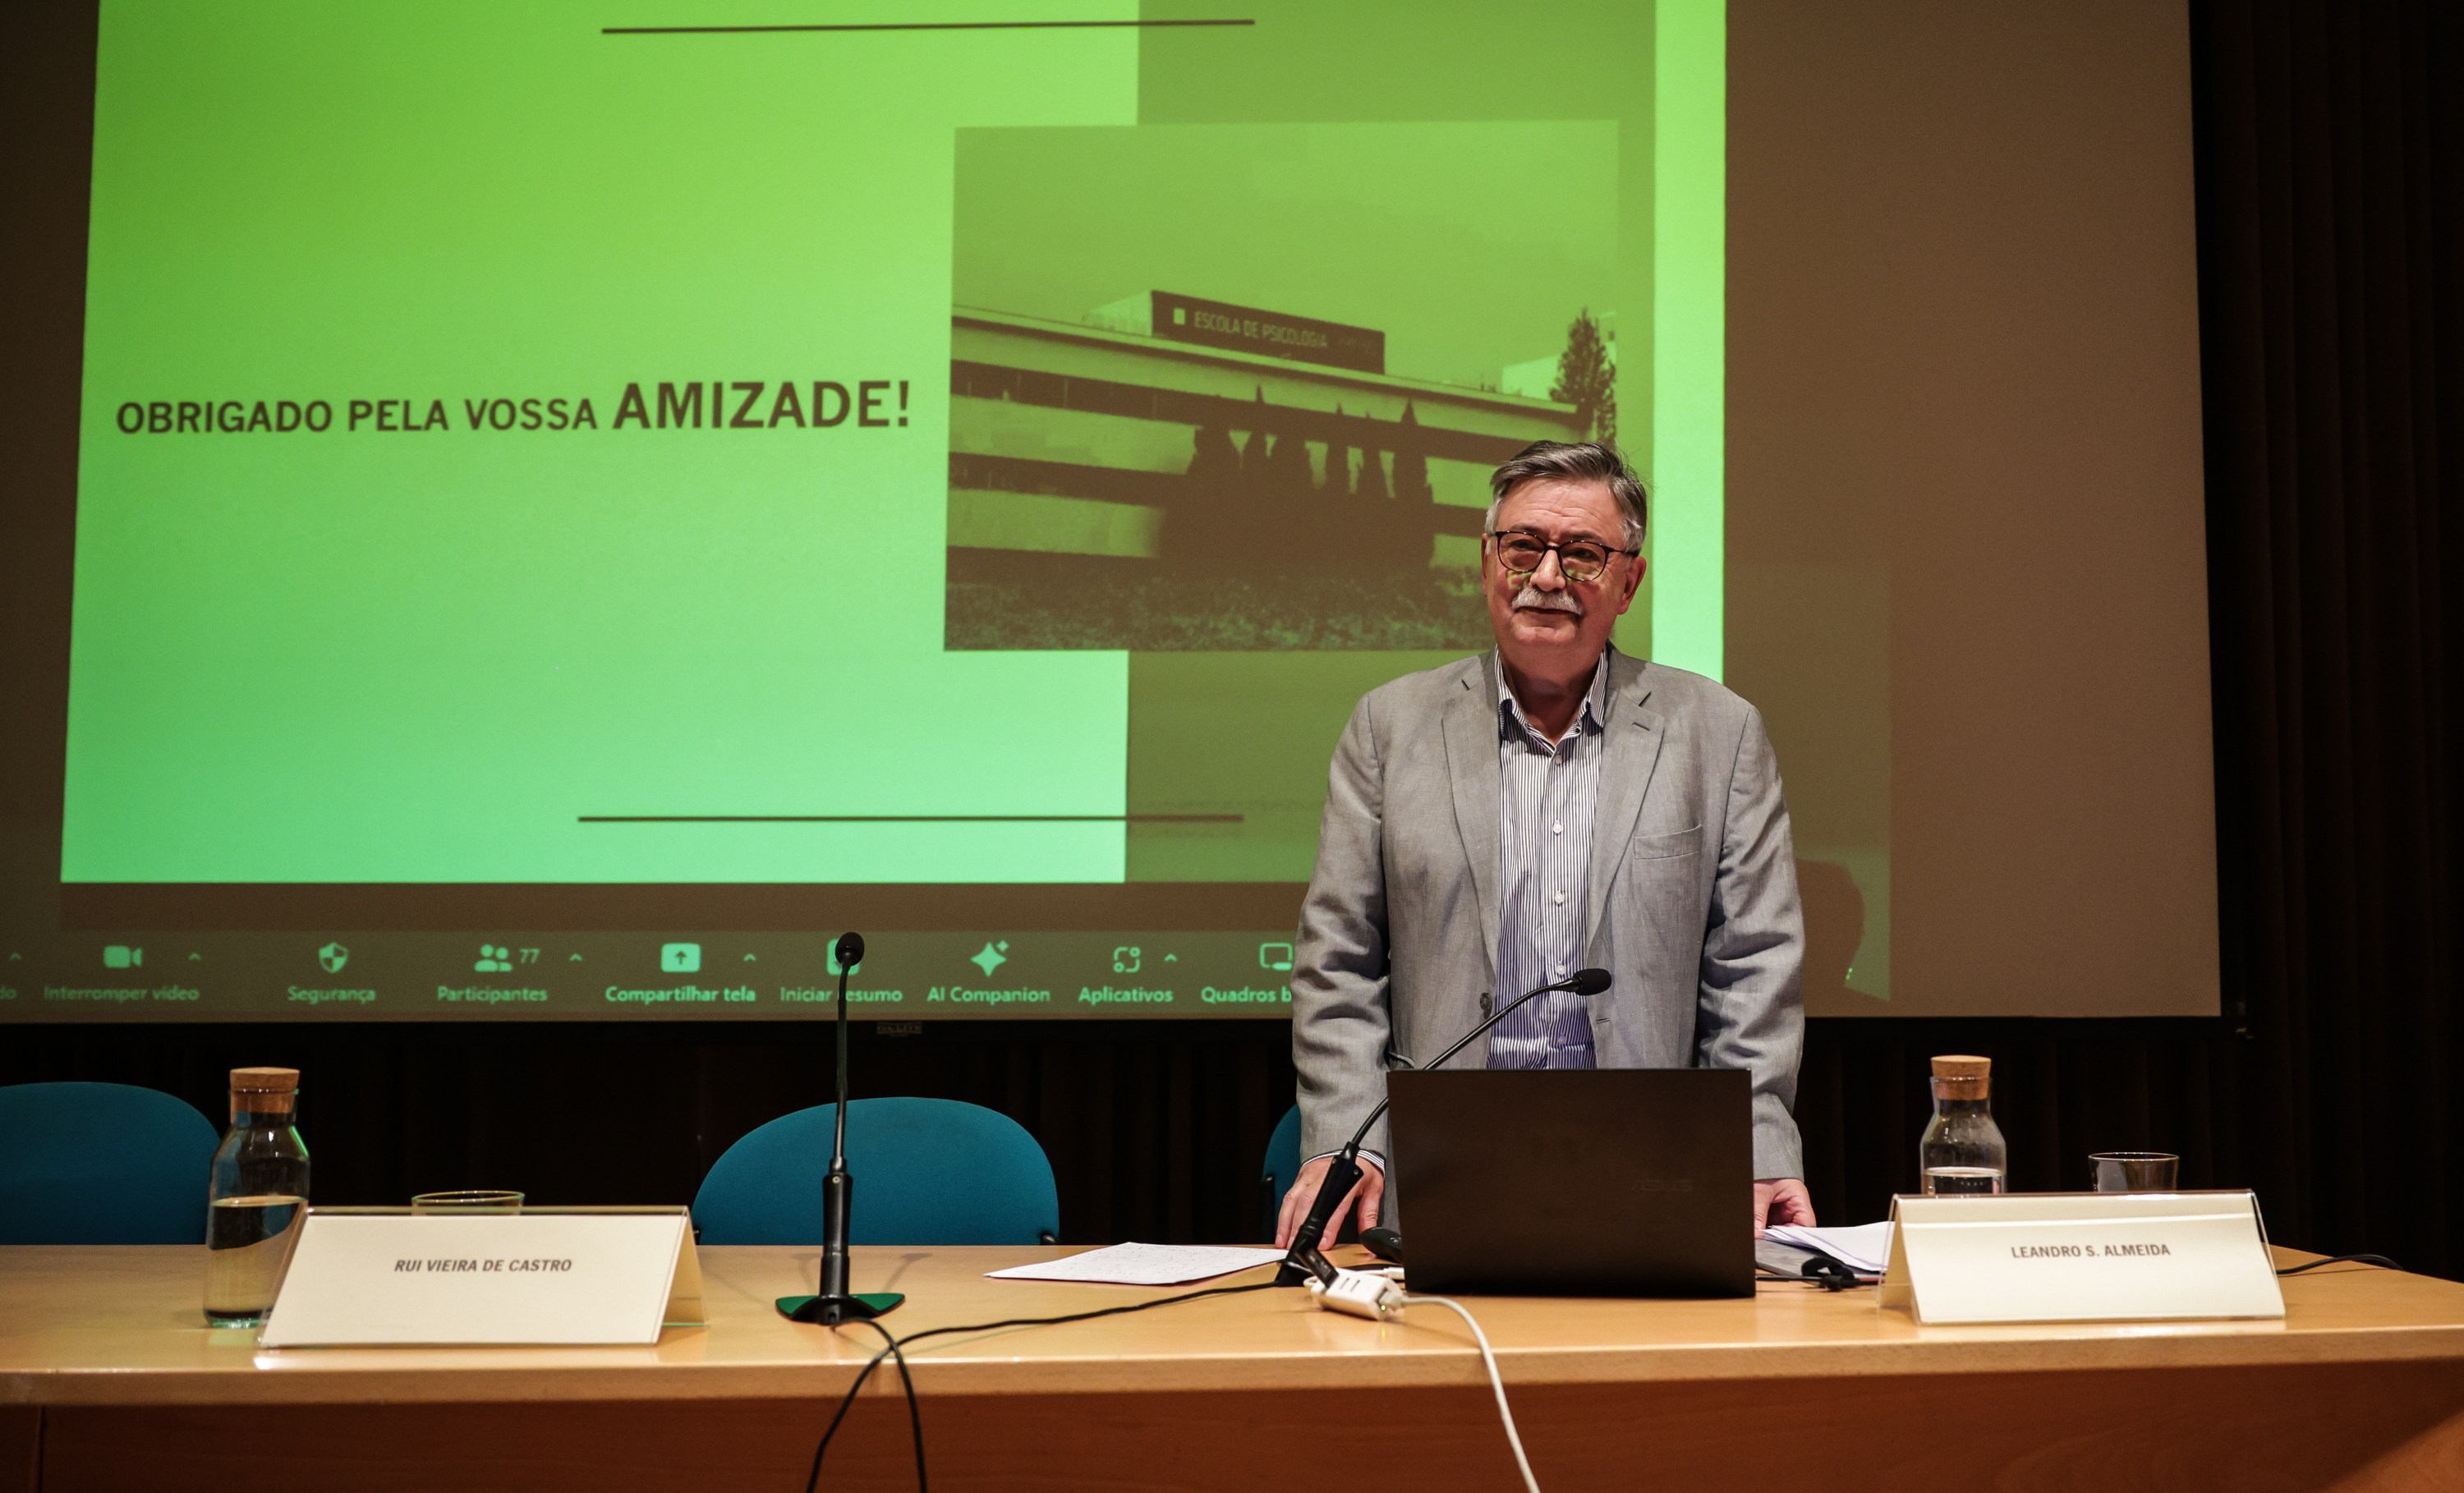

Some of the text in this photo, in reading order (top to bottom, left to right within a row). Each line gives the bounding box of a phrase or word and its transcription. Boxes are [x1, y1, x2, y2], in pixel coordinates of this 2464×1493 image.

[1194, 310, 1328, 349] ESCOLA DE PSICOLOGIA
[116, 379, 910, 434] OBRIGADO PELA VOSSA AMIZADE!
[519, 948, 541, 964] 77
[44, 985, 148, 1004] Interromper
[287, 985, 376, 1004] Segurança
[437, 985, 548, 1004] Participantes
[605, 985, 756, 1005] Compartilhar tela
[780, 986, 903, 1003] Iniciar esumo
[926, 986, 1050, 1006] AI Companion
[1078, 985, 1174, 1006] Aplicativos
[1201, 986, 1277, 1005] Quadros
[2011, 1243, 2172, 1258] LEANDRO S. ALMEIDA
[394, 1258, 572, 1272] RUI VIEIRA DE CASTRO
